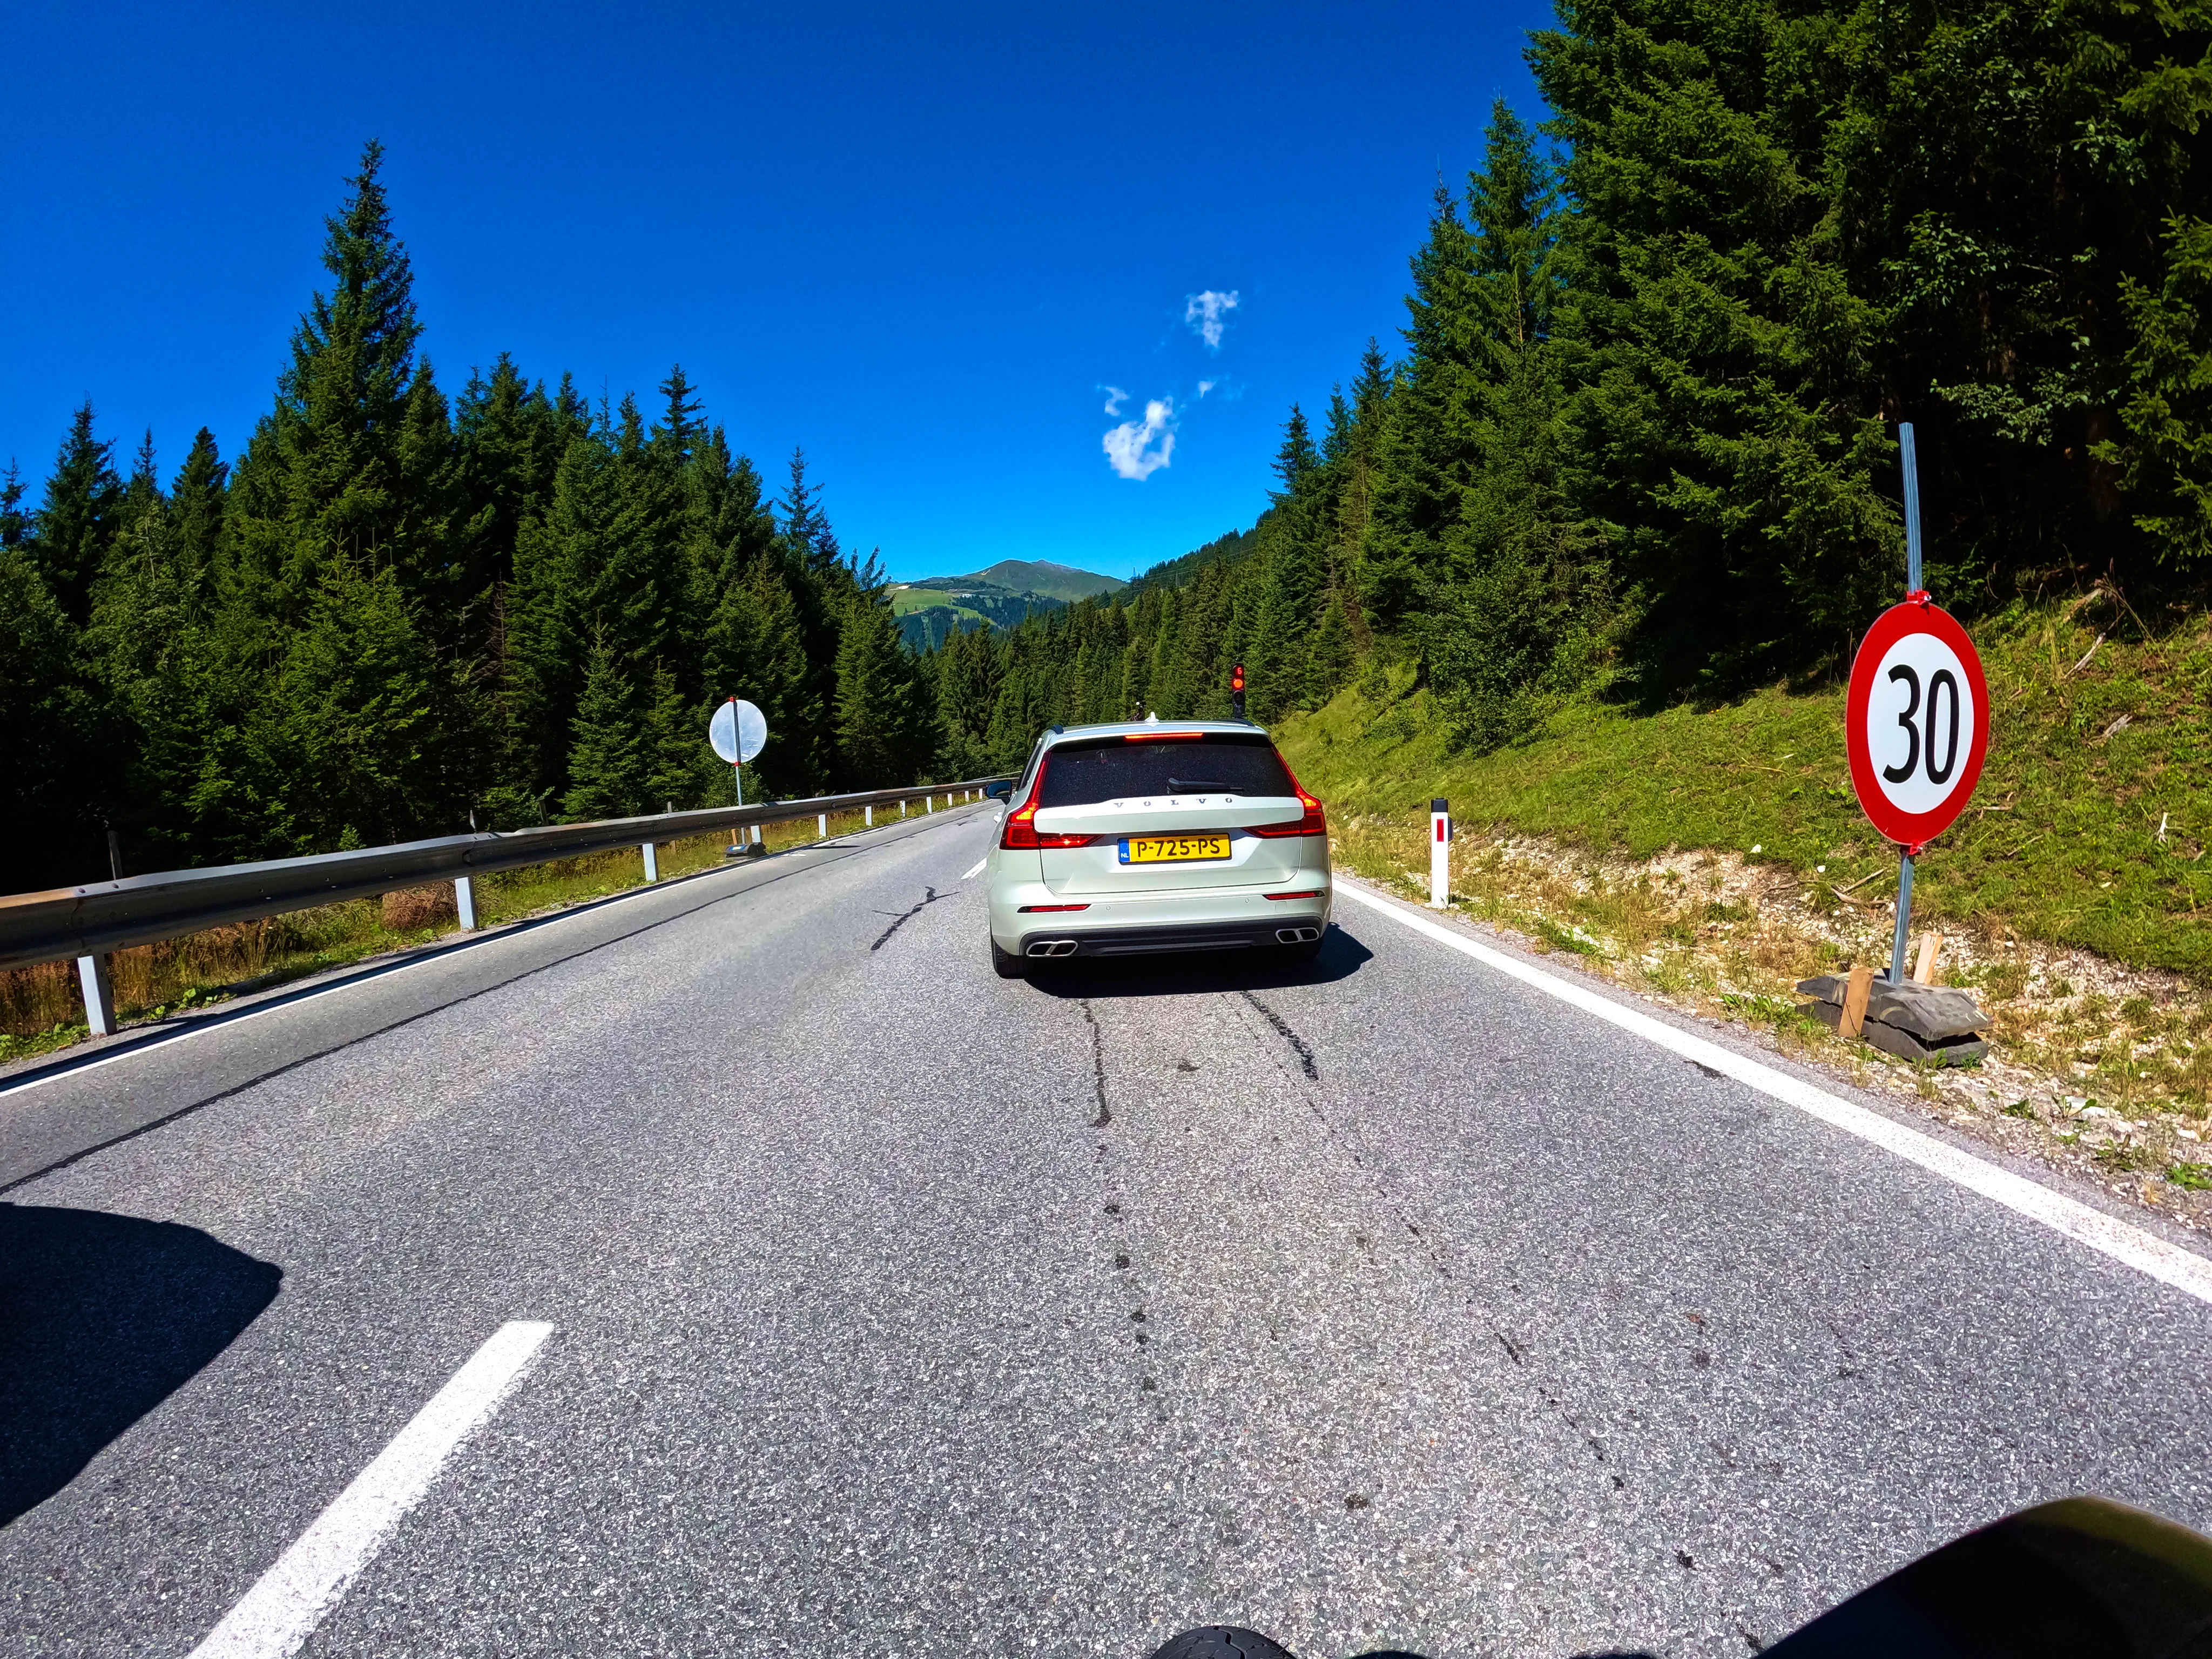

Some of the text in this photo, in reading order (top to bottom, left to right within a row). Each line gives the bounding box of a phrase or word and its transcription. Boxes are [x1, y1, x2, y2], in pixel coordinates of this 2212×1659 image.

[1883, 664, 1959, 785] 30
[1114, 797, 1233, 808] VOLVO
[1137, 838, 1220, 858] P-725-PS
